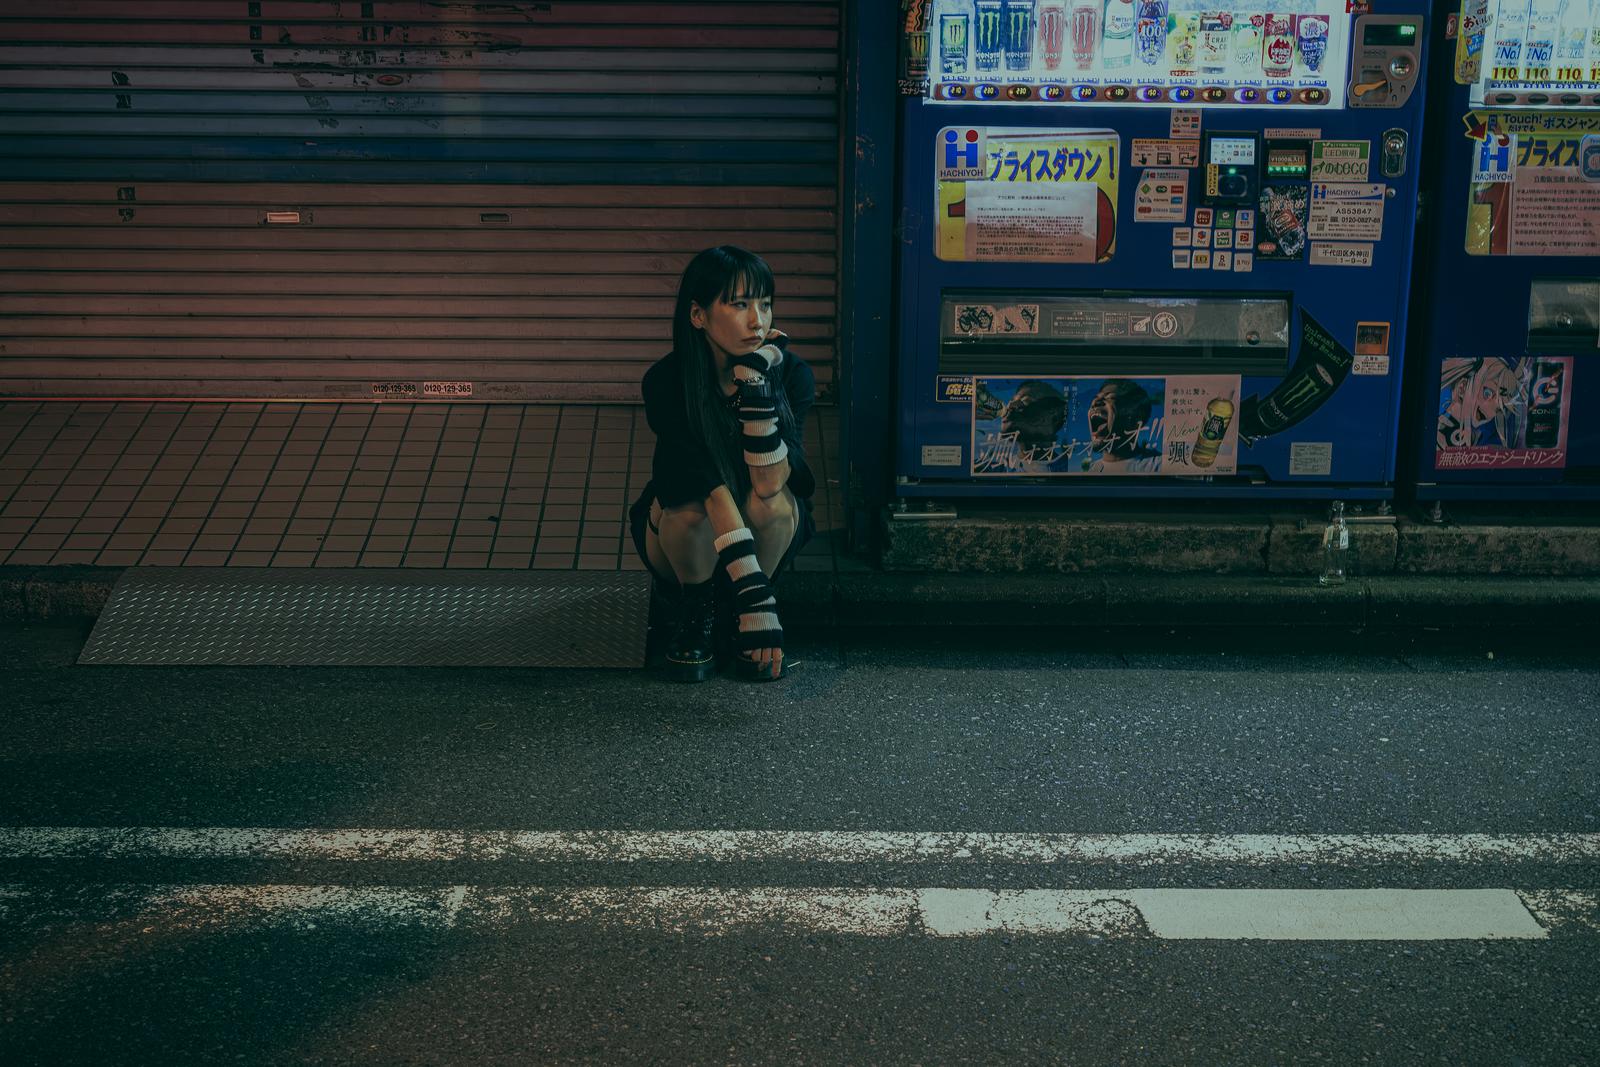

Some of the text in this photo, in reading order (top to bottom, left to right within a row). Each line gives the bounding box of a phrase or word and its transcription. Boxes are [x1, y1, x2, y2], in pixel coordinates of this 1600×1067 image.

[1493, 68, 1518, 80] 110
[1525, 68, 1549, 80] 110
[1557, 68, 1582, 80] 110
[1503, 113, 1542, 124] Touch!
[1544, 117, 1600, 130] ボスジャン
[1508, 124, 1536, 132] だけでも
[1518, 136, 1580, 167] プライス
[940, 168, 983, 178] HACHIYOH
[1474, 173, 1513, 181] HACHIYOH
[1304, 323, 1336, 349] Unleash
[424, 384, 471, 393] 0120-129-365
[1438, 451, 1564, 467] 無敵のエナジードリンク
